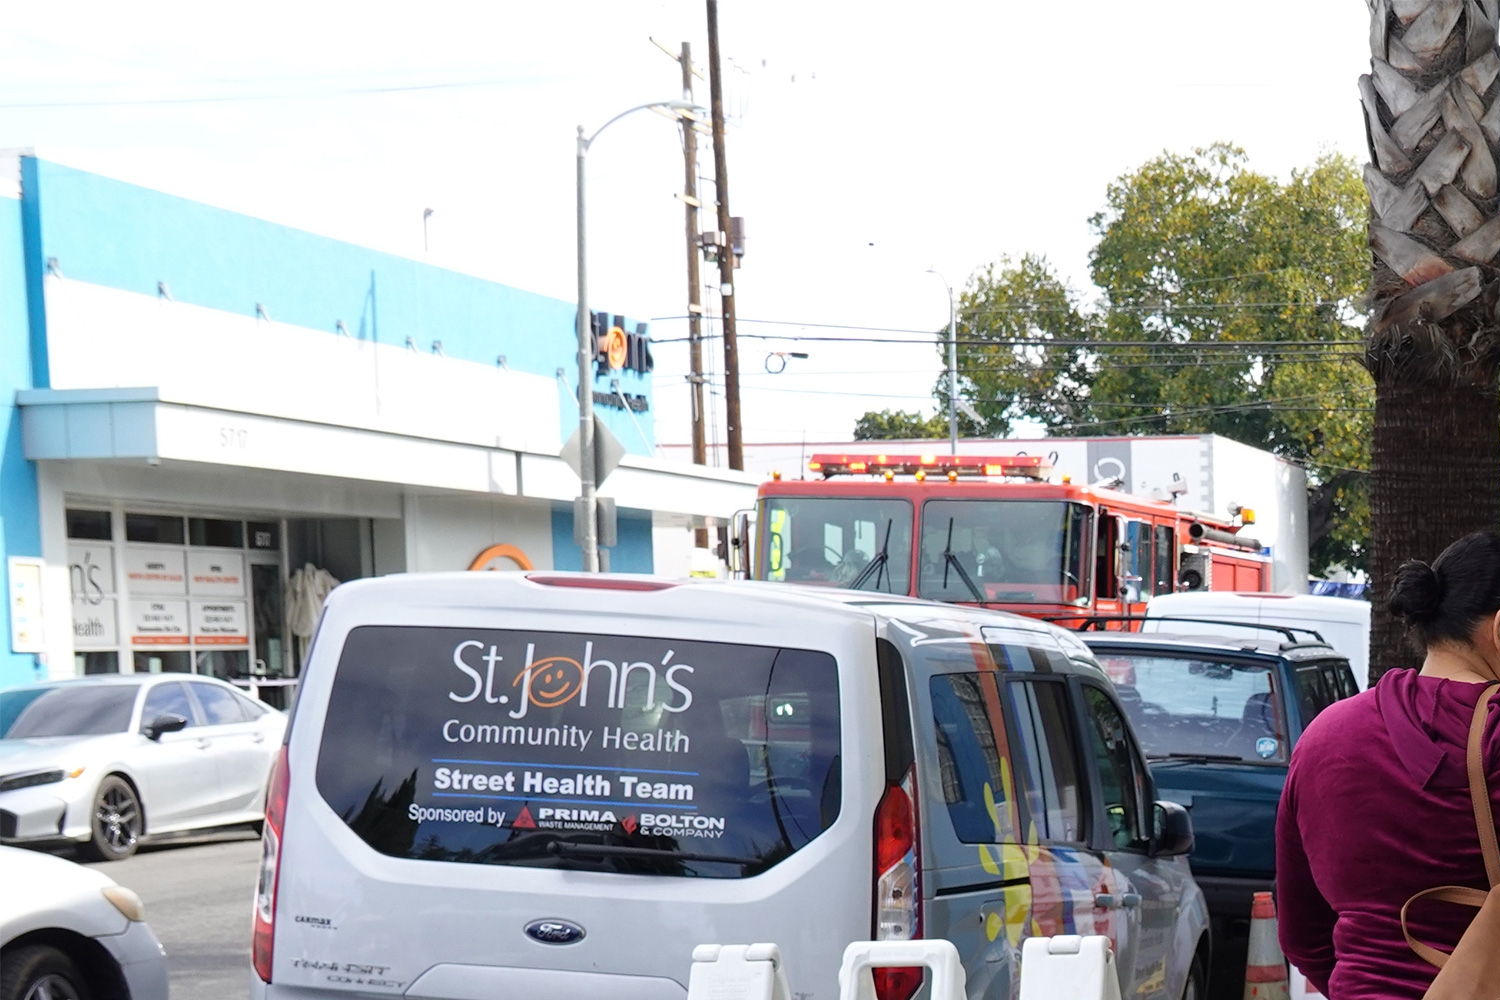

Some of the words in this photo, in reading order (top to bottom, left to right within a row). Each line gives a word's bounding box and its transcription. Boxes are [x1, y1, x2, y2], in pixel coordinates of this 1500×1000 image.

[509, 641, 694, 719] John's
[442, 719, 592, 752] Community
[602, 726, 690, 753] Health
[434, 767, 515, 792] Street
[523, 771, 611, 796] Health
[619, 776, 694, 800] Team
[408, 803, 485, 824] Sponsored
[488, 806, 506, 827] by
[538, 807, 618, 822] PRIMA
[640, 813, 725, 829] BOLTON
[538, 820, 564, 830] WASTE
[564, 821, 615, 832] MANAGEMENT
[640, 826, 649, 836] &
[652, 827, 725, 839] COMPANY
